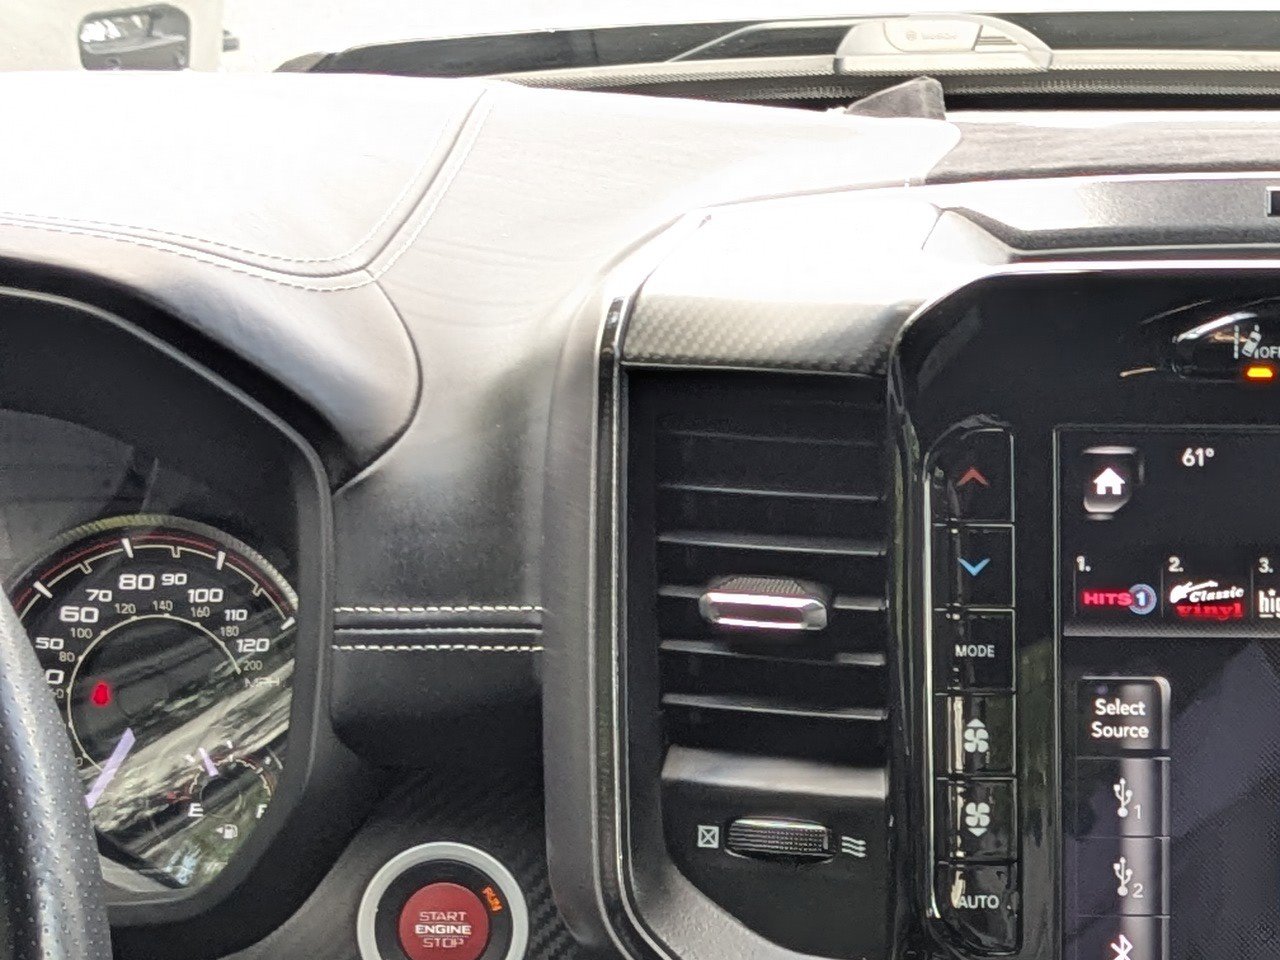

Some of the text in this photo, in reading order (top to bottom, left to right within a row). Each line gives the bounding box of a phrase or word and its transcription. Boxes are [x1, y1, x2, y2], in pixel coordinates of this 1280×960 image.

[1182, 447, 1215, 467] 61°
[1076, 556, 1091, 572] 1.
[1168, 556, 1184, 572] 2.
[1258, 557, 1274, 573] 3.
[119, 573, 155, 590] 80
[162, 573, 187, 585] 90
[86, 589, 112, 602] 70
[187, 588, 224, 603] 100
[1083, 592, 1132, 606] HITS
[1189, 586, 1244, 603] Classic
[114, 603, 136, 614] 120
[153, 600, 174, 611] 140
[190, 606, 210, 617] 160
[1176, 603, 1243, 621] vinyl
[60, 606, 99, 623] 60
[224, 609, 248, 621] 110
[70, 627, 93, 639] 100
[220, 625, 240, 637] 180
[35, 637, 64, 650] 50
[236, 638, 270, 652] 120
[59, 652, 75, 662] 80
[955, 644, 995, 658] MODE
[243, 660, 263, 671] 200
[1095, 698, 1146, 716] Select
[1091, 721, 1149, 739] Source
[188, 803, 204, 817] E
[256, 804, 267, 818] F
[1134, 804, 1143, 820] 1
[1132, 882, 1144, 899] 2
[957, 895, 999, 909] AUTO
[419, 911, 467, 921] START
[415, 924, 472, 935] ENGINE
[422, 938, 464, 948] STOP
